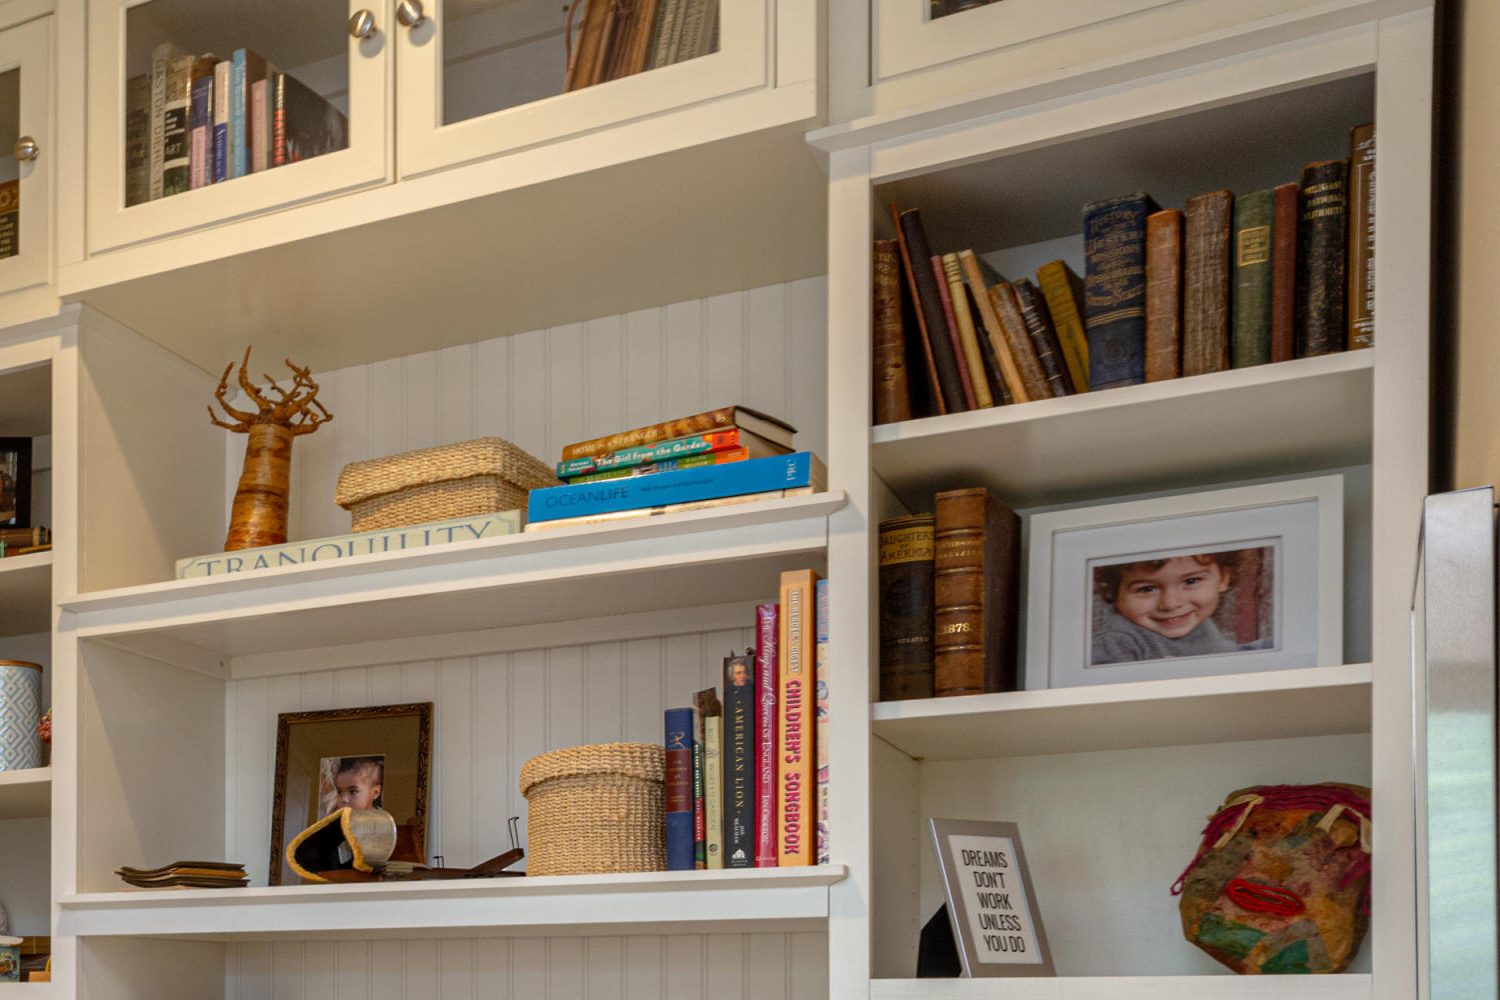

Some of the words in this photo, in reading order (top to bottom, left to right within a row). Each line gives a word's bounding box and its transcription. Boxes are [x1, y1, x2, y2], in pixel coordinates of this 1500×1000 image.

[614, 453, 632, 464] Girl
[633, 449, 654, 461] from
[656, 446, 672, 456] the
[545, 486, 629, 509] OCEANLIFE
[880, 546, 934, 562] AMERICA
[790, 607, 800, 644] READER'S
[790, 646, 800, 673] DIGEST
[785, 679, 802, 765] CHILDREN'S
[734, 706, 745, 780] AMERICAN
[734, 782, 744, 810] LION
[784, 771, 801, 855] SONGBOOK
[961, 849, 1008, 868] DREAMS
[973, 871, 1007, 890] DON'T
[976, 892, 1013, 911] WORK
[979, 913, 1022, 933] UNLESS
[983, 934, 1009, 953] YOU
[1009, 935, 1026, 954] DO
